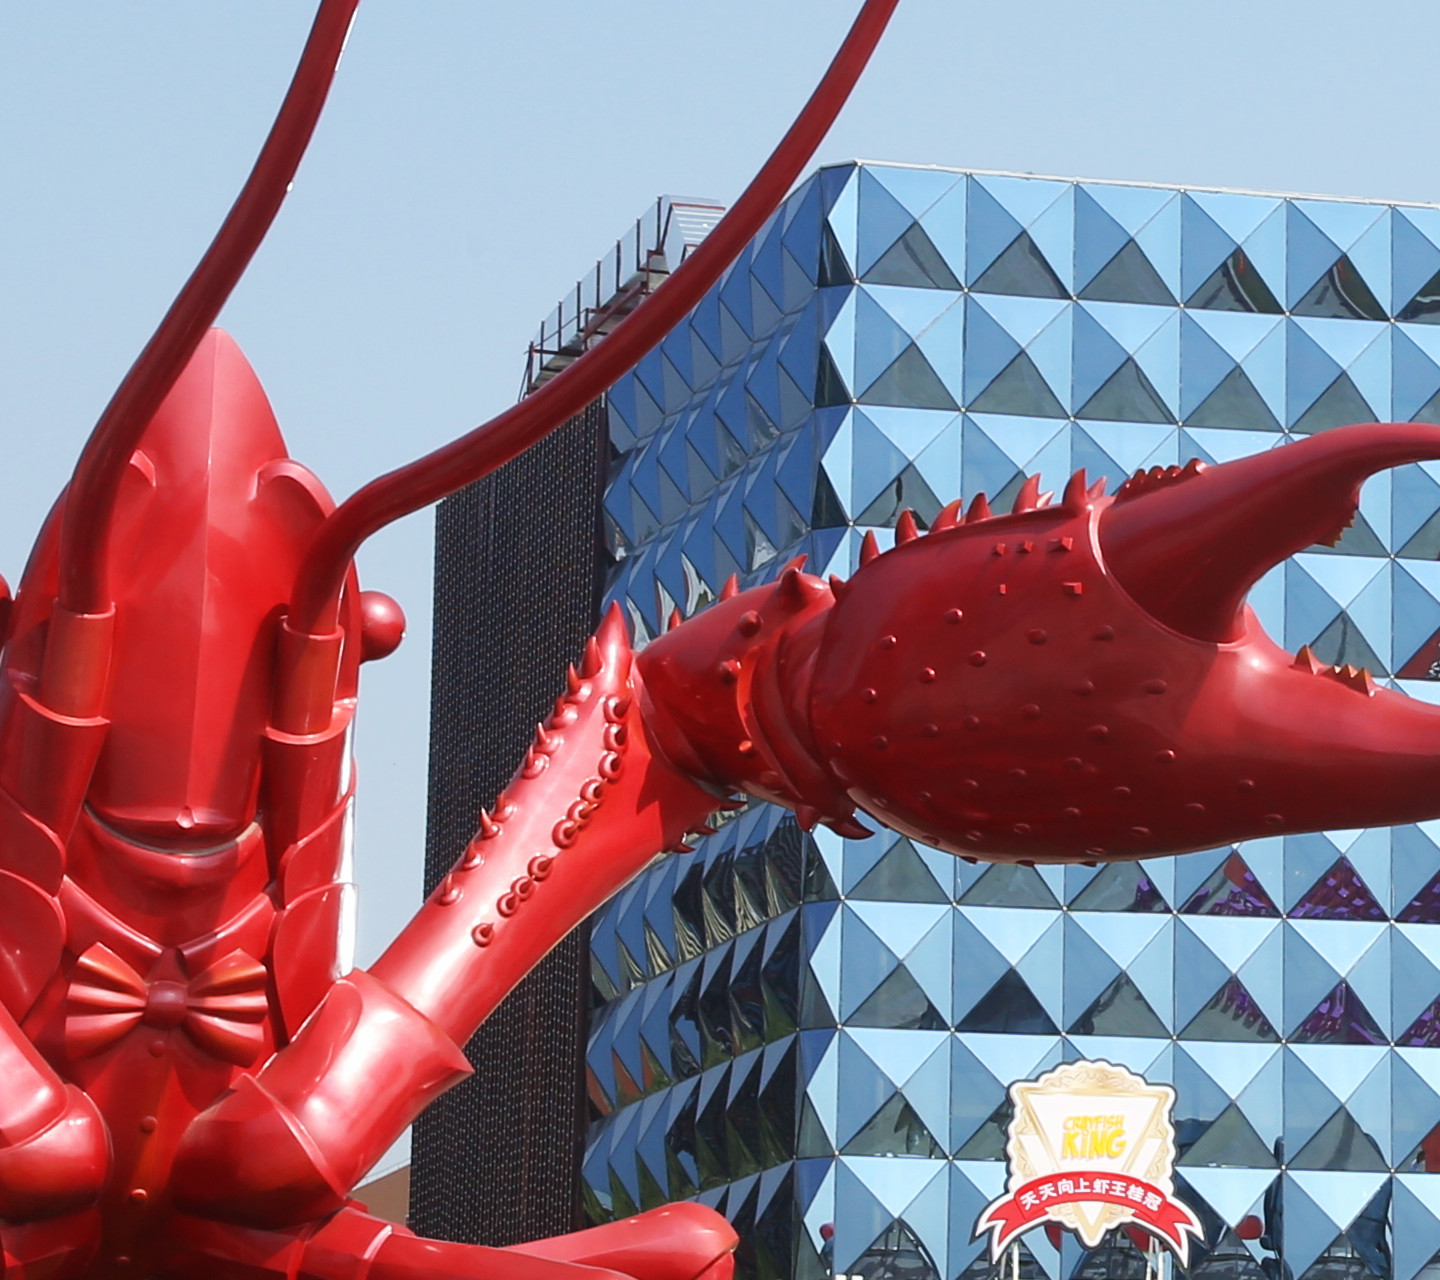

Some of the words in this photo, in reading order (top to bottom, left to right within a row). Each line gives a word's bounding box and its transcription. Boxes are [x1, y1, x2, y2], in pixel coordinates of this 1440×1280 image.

[1063, 1114, 1125, 1131] CRAYFISH
[1019, 1177, 1163, 1212] 天天向上虾王桂冠
